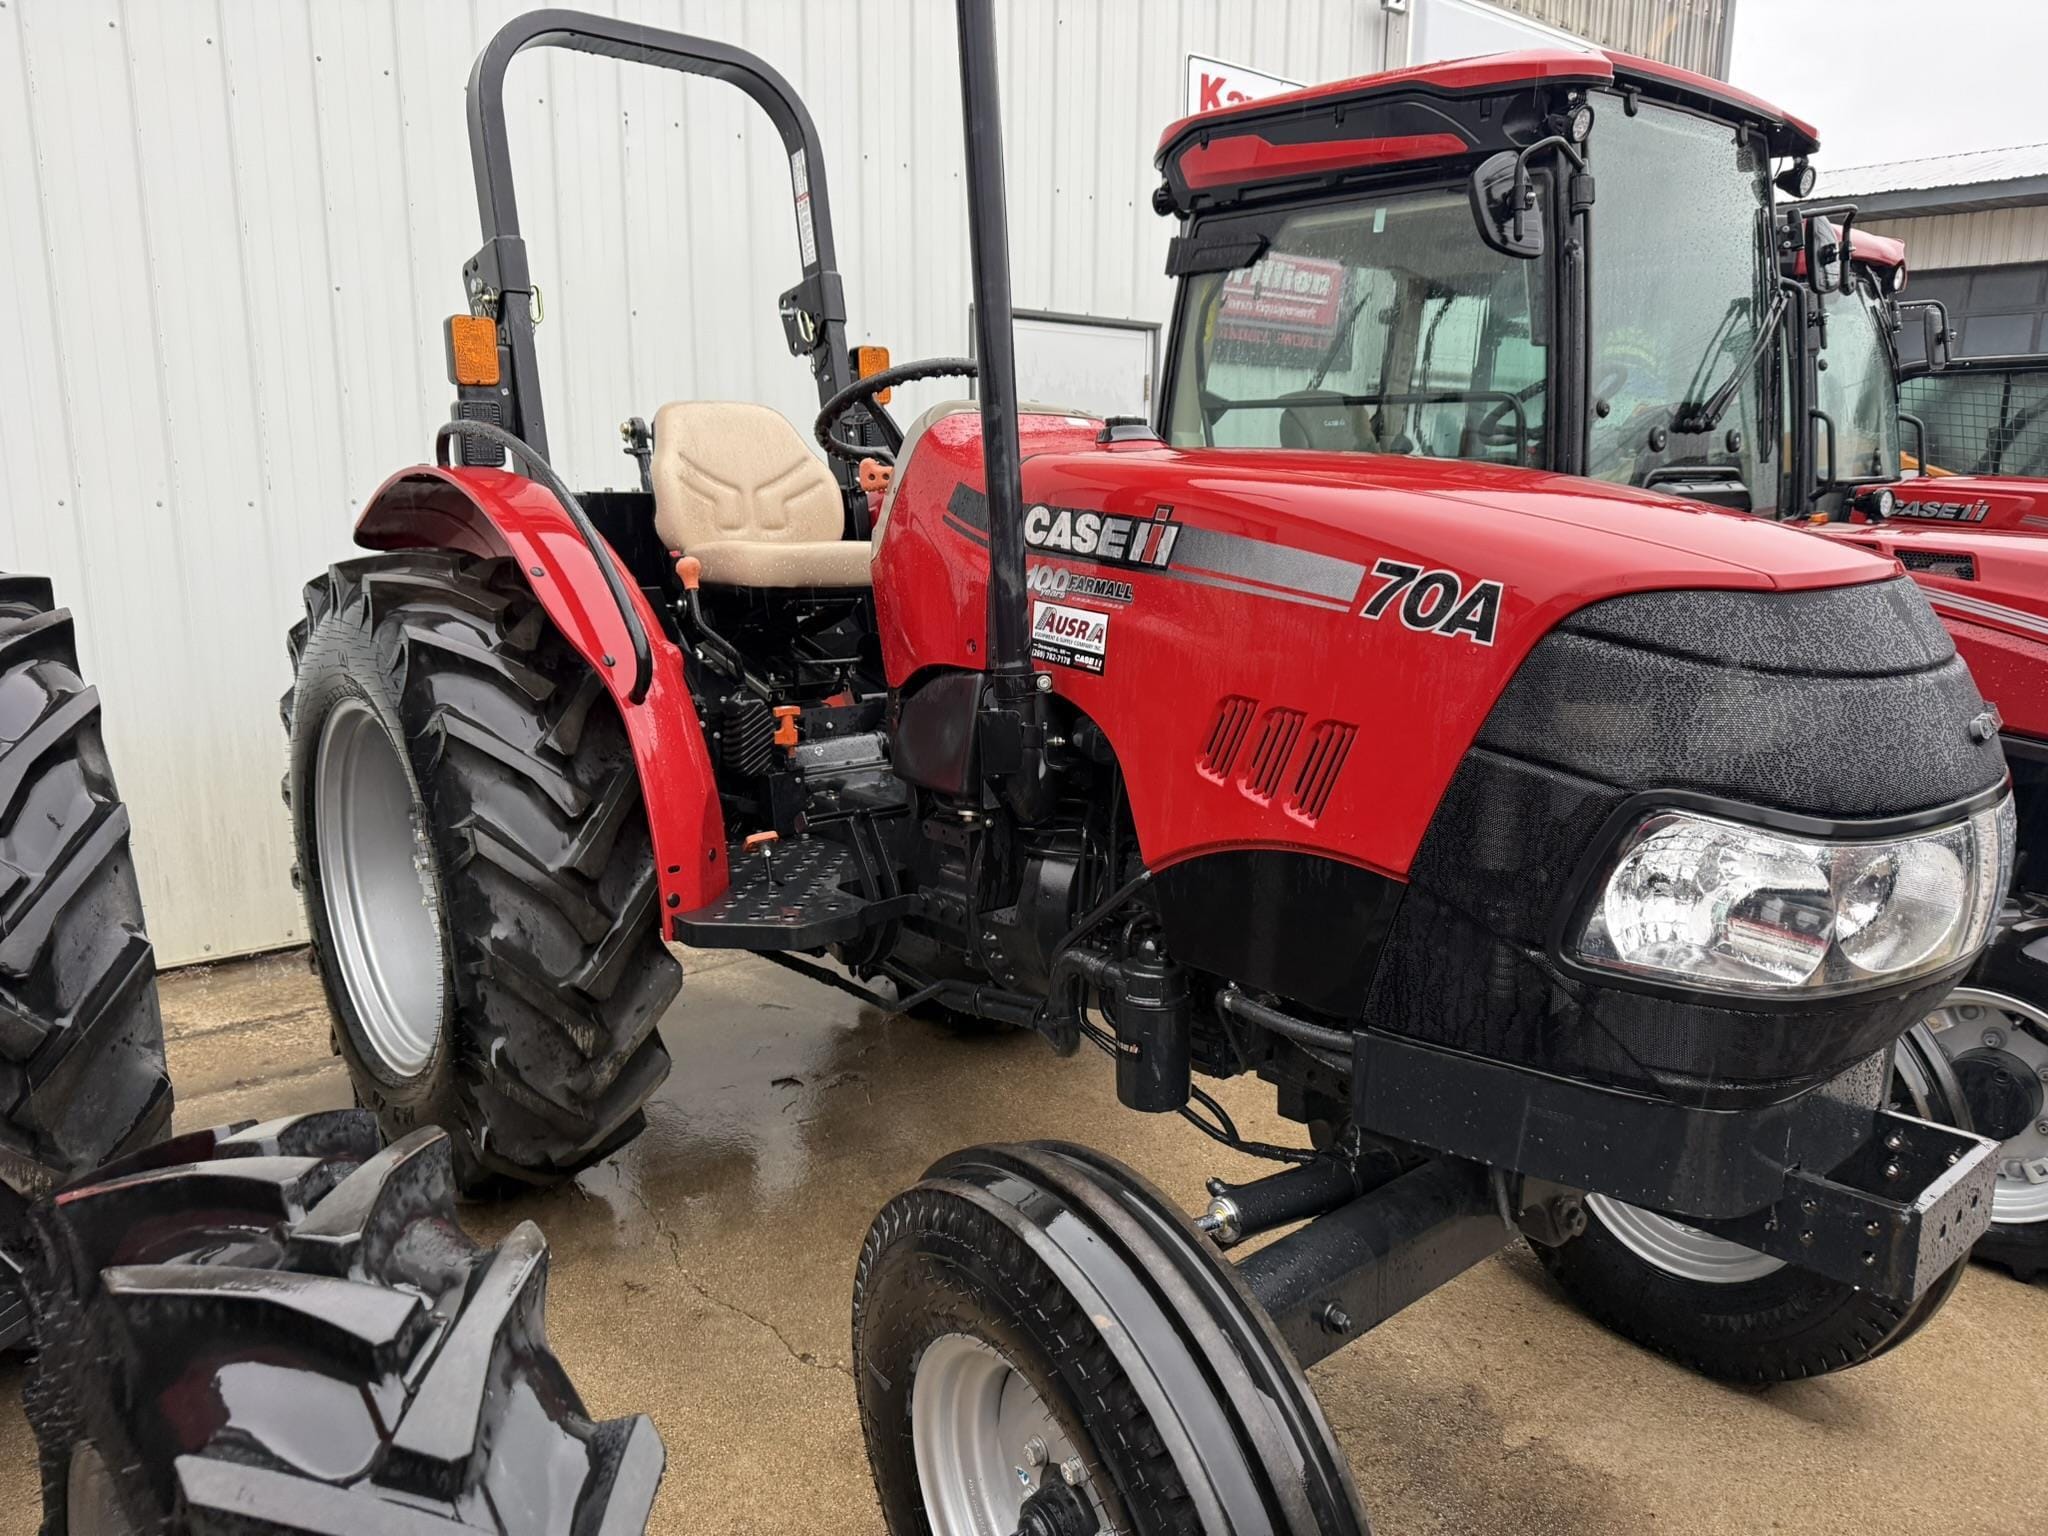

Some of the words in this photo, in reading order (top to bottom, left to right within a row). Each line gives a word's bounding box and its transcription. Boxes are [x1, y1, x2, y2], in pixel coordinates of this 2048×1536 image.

[1224, 259, 1332, 297] rillion
[1024, 505, 1132, 558] CASE
[1068, 575, 1133, 602] FARMALL
[1359, 557, 1504, 647] 70A
[1034, 606, 1105, 643] AUSRA
